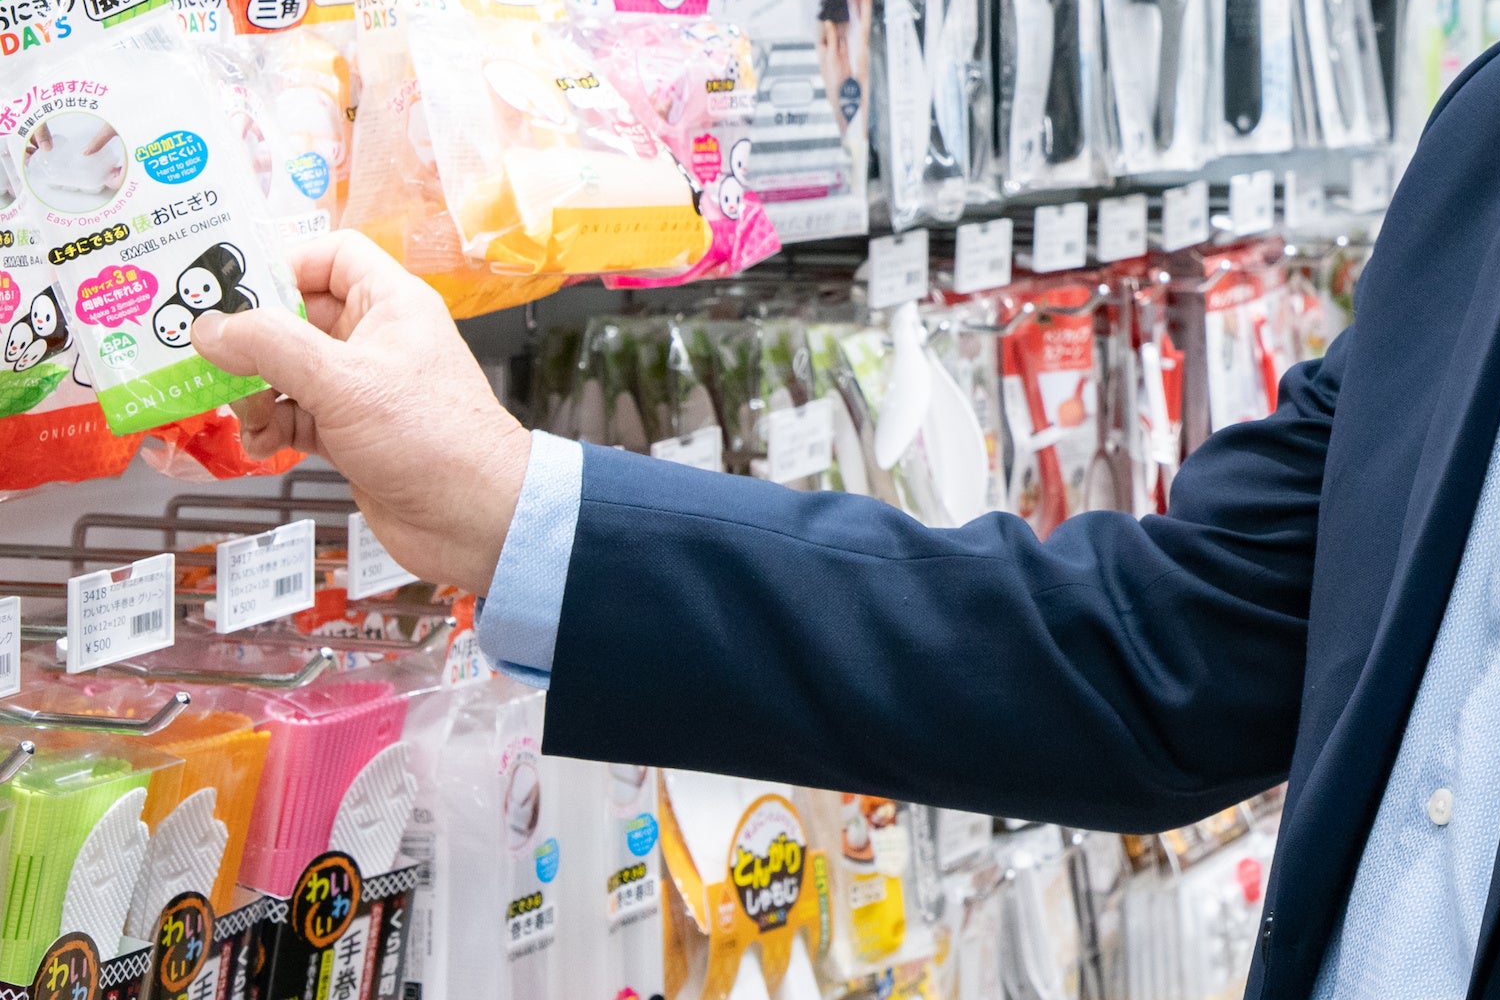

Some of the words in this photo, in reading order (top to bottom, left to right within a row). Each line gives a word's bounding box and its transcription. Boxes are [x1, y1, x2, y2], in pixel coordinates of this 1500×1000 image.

[177, 10, 218, 34] DAYS
[363, 8, 397, 31] DAYS
[0, 15, 72, 56] DAYS
[18, 96, 99, 138] 簡単に取り出せる
[135, 132, 194, 162] 凸凹加工で
[156, 165, 175, 177] Hard
[176, 163, 184, 172] to
[185, 156, 201, 169] stick
[167, 173, 181, 182] the
[181, 167, 197, 179] rice!
[46, 211, 73, 227] Easy
[103, 199, 128, 219] Push
[125, 181, 139, 198] out
[131, 189, 218, 234] 俵おにぎり
[120, 238, 159, 262] SMALL
[161, 229, 188, 247] BALE
[190, 212, 232, 234] ONIGIRI
[3, 255, 29, 268] SMALL
[103, 336, 133, 353] BPA
[125, 371, 215, 415] ONIGIRI
[39, 420, 97, 443] ONIGIRI
[83, 587, 108, 604] 3418
[83, 598, 136, 620] わいわい手巻き
[137, 588, 165, 608] グリーン
[734, 832, 801, 889] とんがり
[745, 878, 799, 916] しゃもじ
